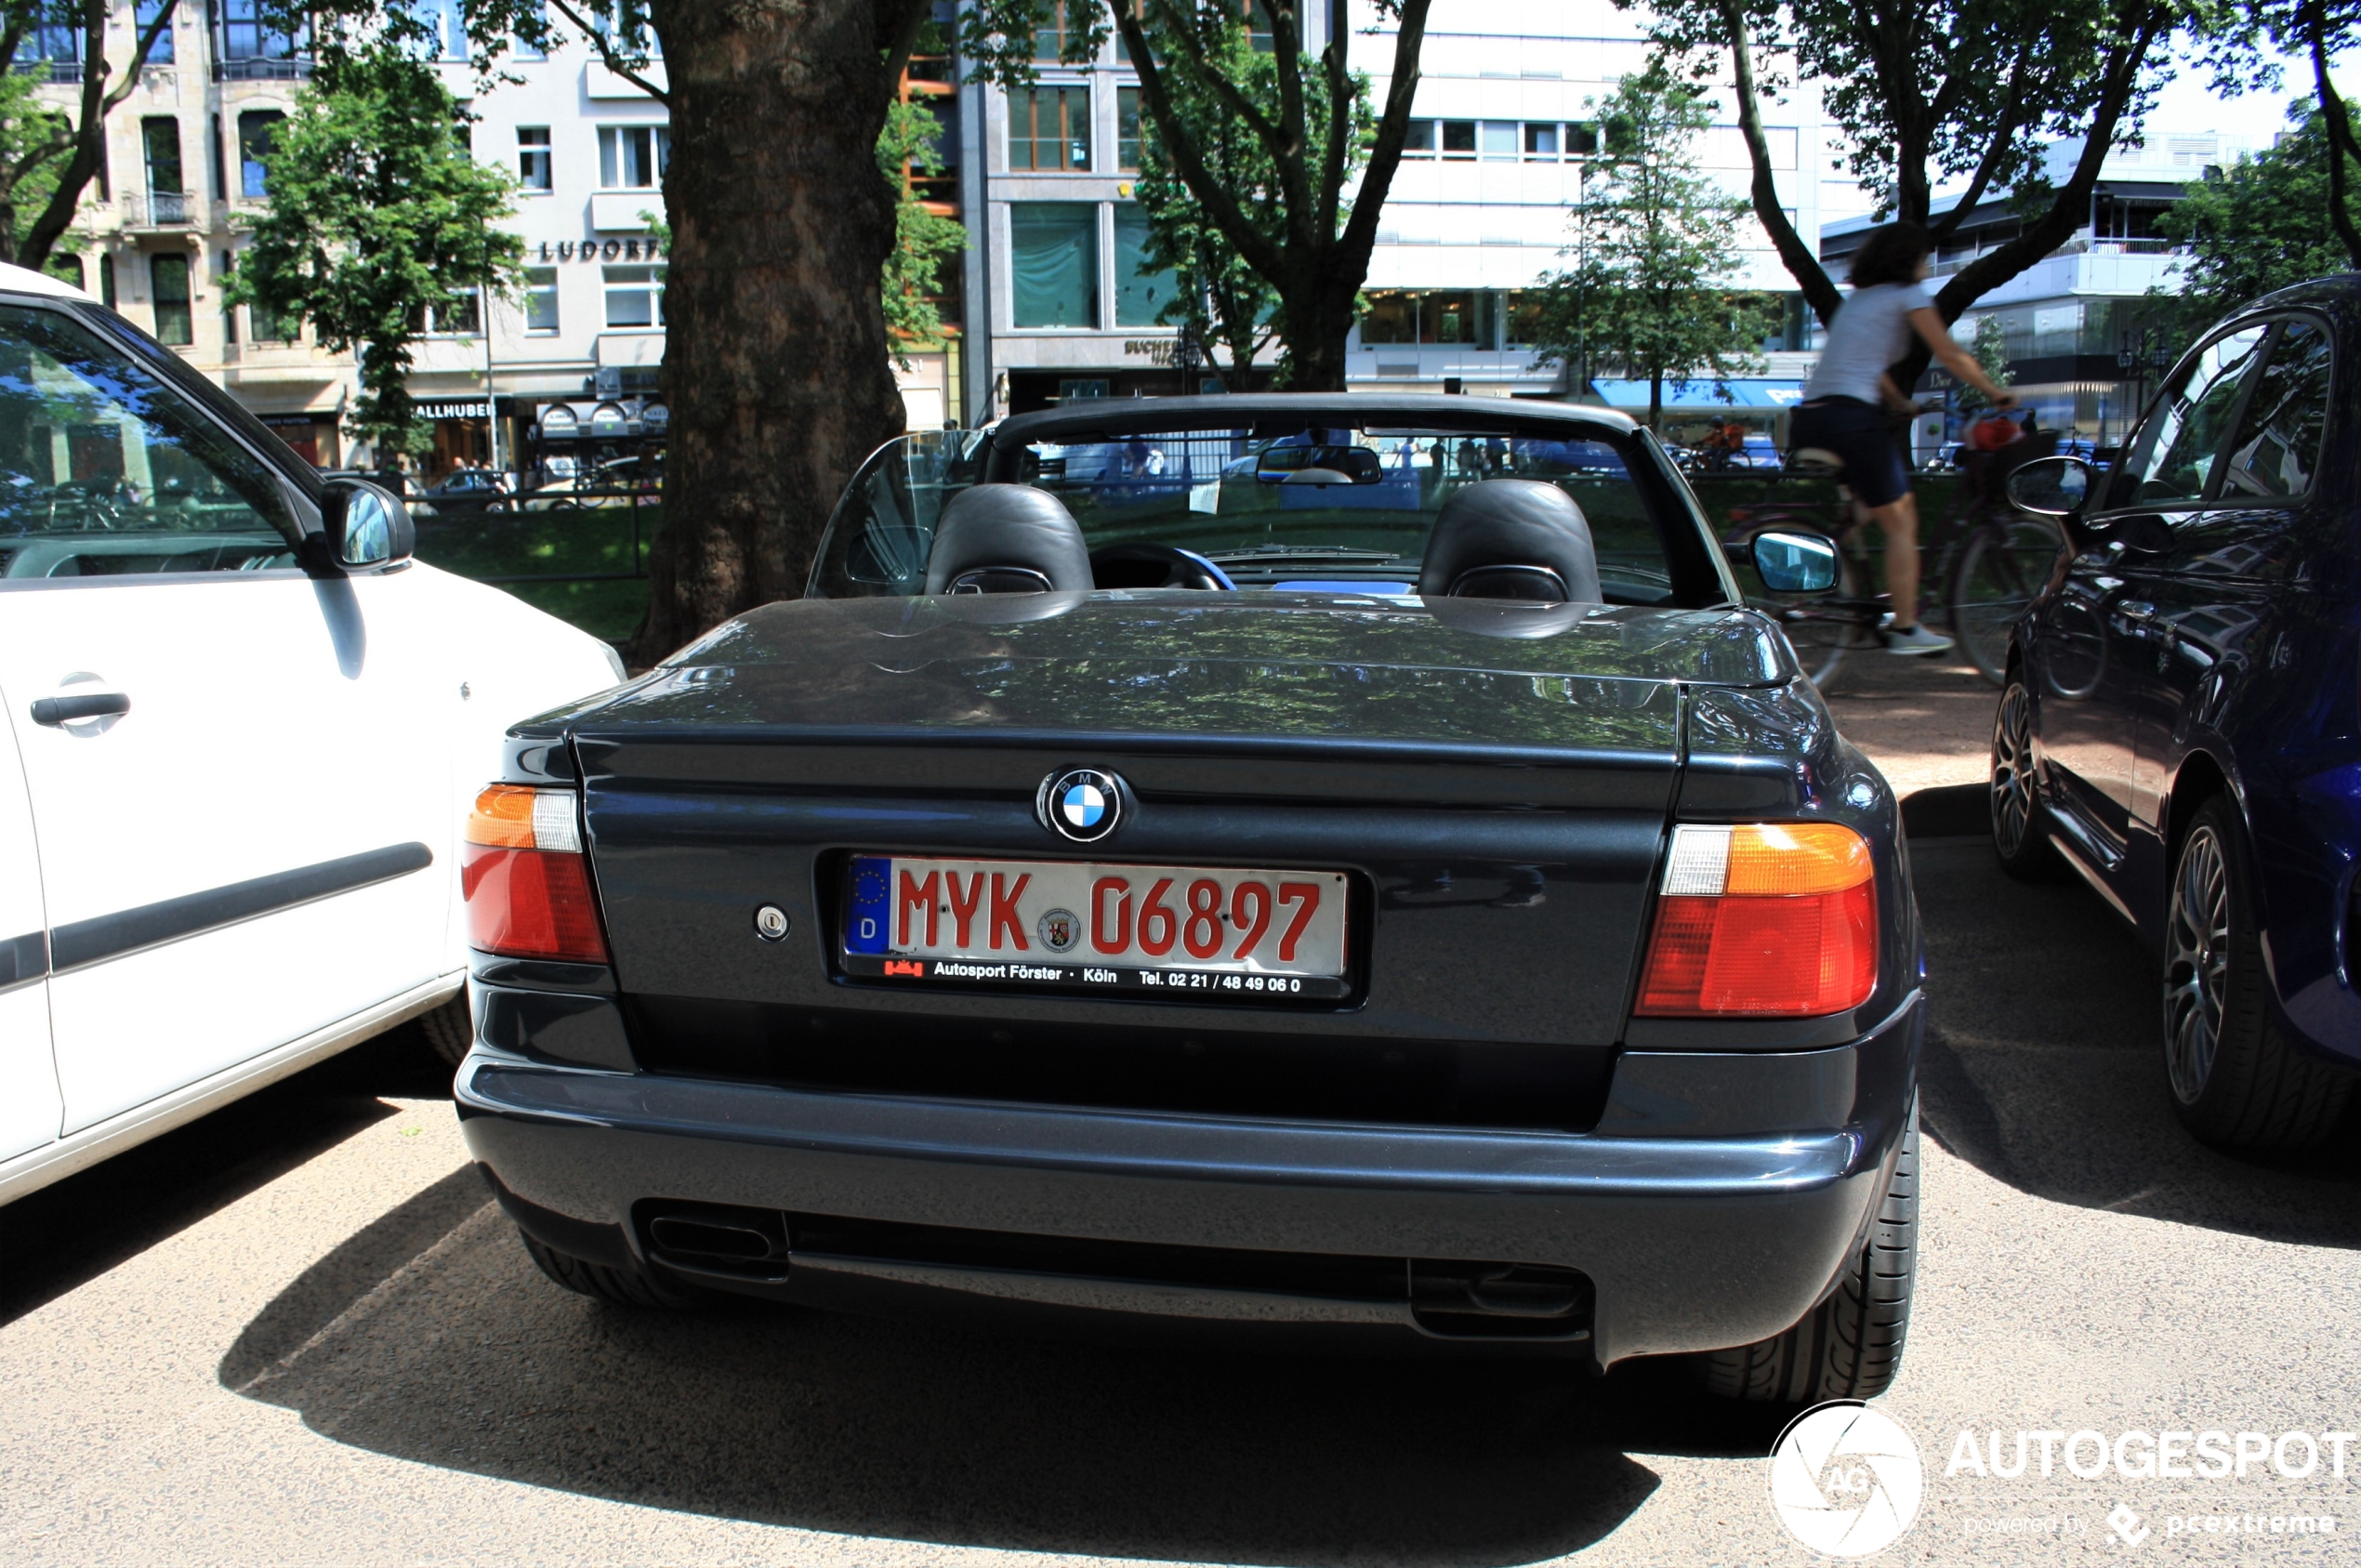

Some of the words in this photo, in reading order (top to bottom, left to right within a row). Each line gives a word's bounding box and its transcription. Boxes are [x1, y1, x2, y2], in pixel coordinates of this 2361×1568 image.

[540, 239, 658, 261] LUDORF
[1929, 371, 1952, 389] Dior
[410, 403, 496, 419] ALLHUBER
[1058, 773, 1113, 796] BMW
[897, 870, 1031, 951] MYK
[1090, 876, 1320, 962] 06897
[861, 918, 876, 939] D
[934, 961, 1006, 980] Autosport
[1009, 964, 1062, 981] Förster
[1084, 968, 1117, 983] Köln
[1140, 970, 1164, 986] Tel.
[1168, 972, 1187, 987] 02
[1191, 974, 1207, 988] 21
[1222, 975, 1241, 989] 48
[1245, 976, 1264, 990] 49
[1267, 977, 1286, 992] 06
[1290, 979, 1300, 993] 0
